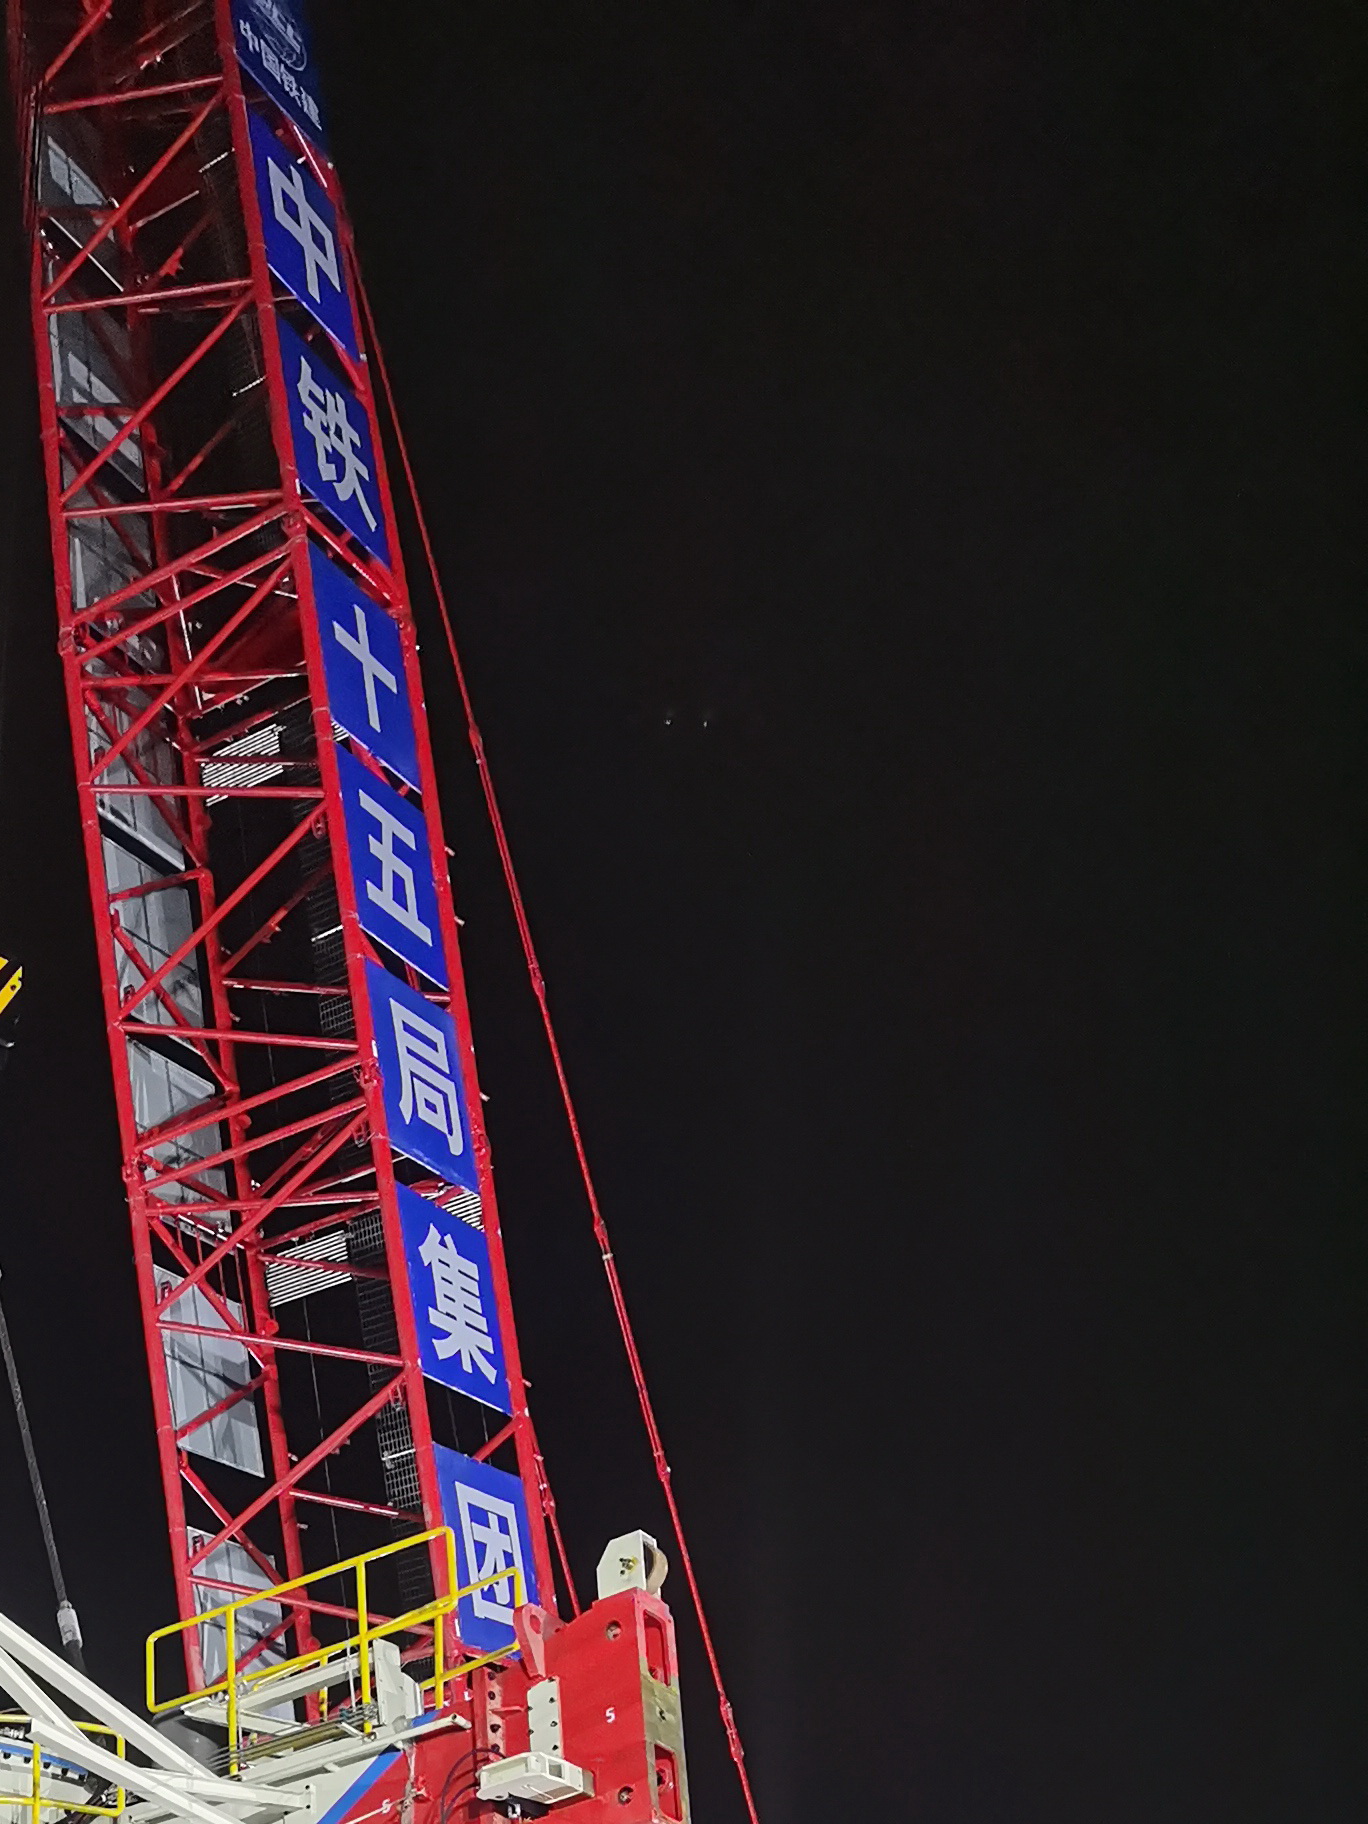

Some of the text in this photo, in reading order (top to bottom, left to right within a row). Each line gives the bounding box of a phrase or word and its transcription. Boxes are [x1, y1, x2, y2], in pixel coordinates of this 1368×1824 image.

[239, 19, 322, 130] 中国铁建
[268, 157, 528, 1626] 中铁十五局集团
